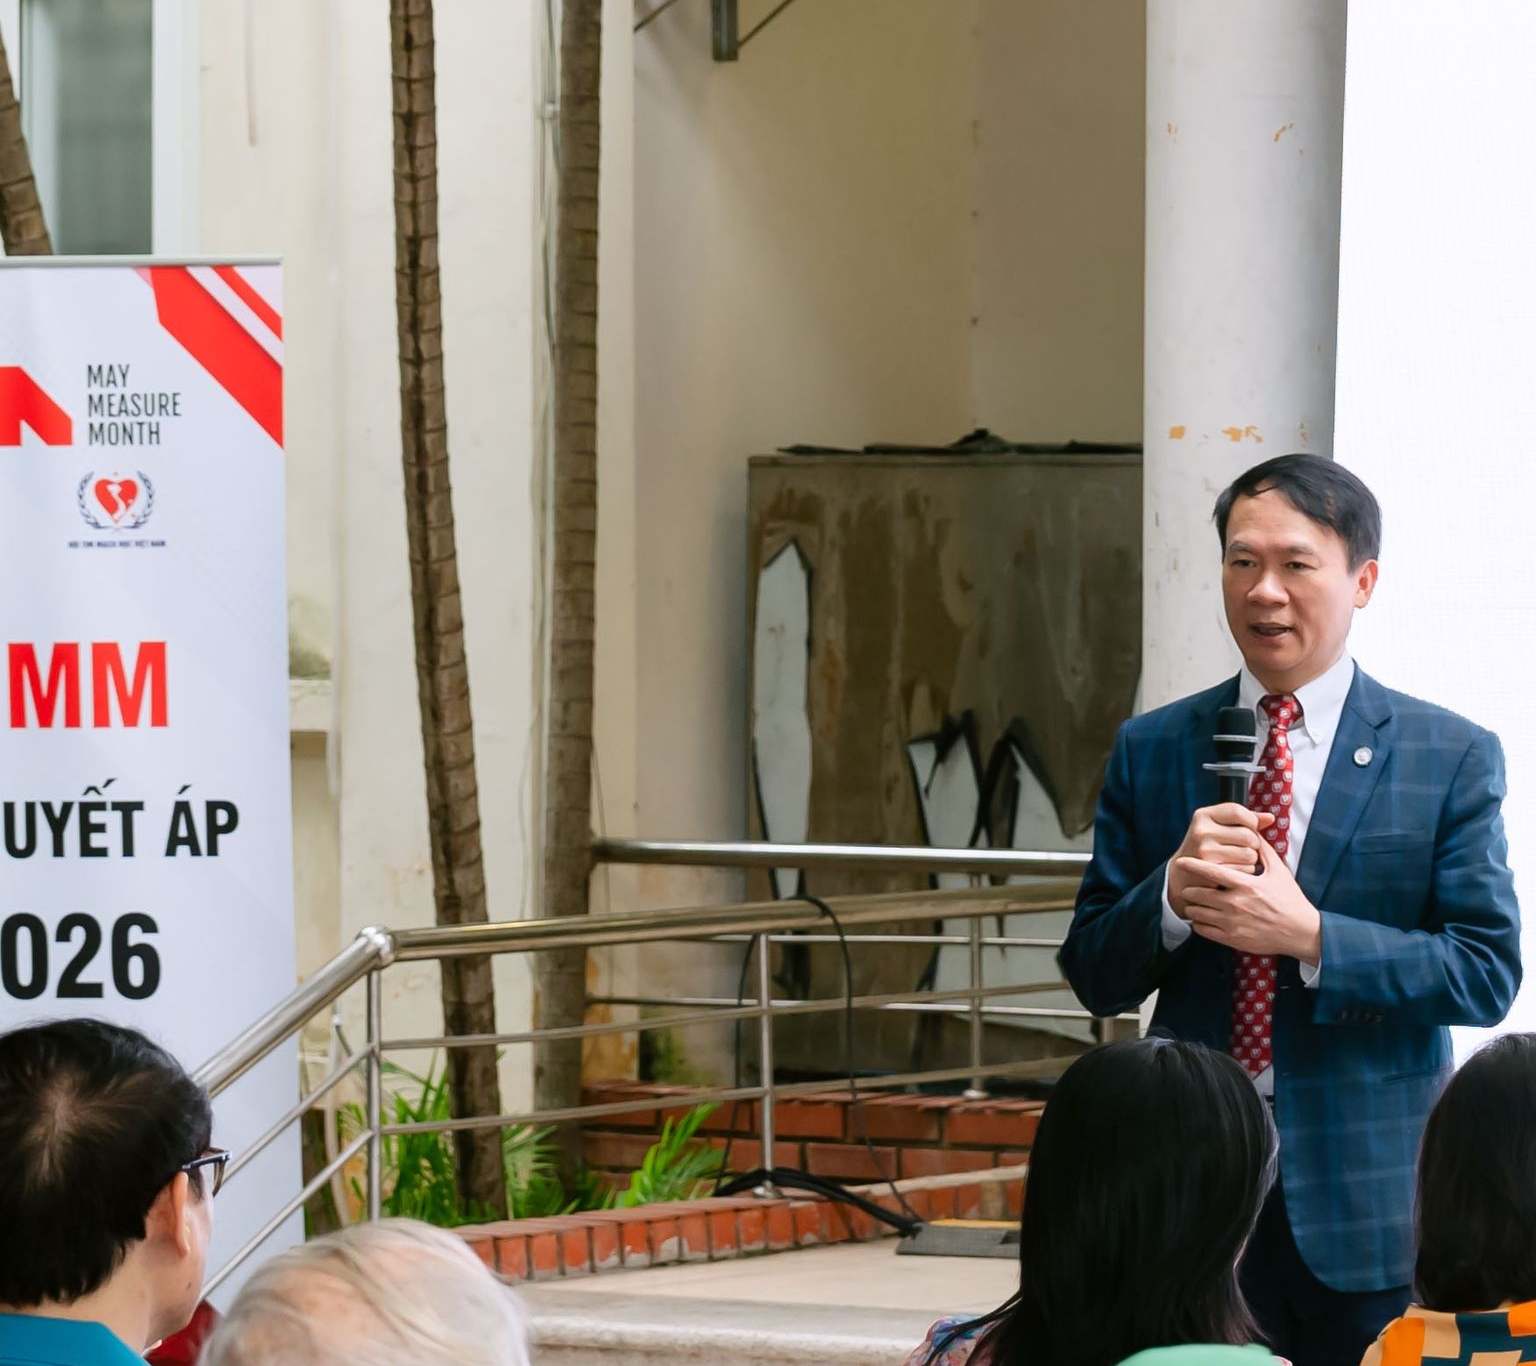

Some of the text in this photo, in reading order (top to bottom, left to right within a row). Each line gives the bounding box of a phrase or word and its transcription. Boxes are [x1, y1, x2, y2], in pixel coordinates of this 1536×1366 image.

[87, 364, 130, 388] MAY
[88, 392, 182, 417] MEASURE
[89, 421, 161, 446] MONTH
[164, 784, 240, 858] ÁP
